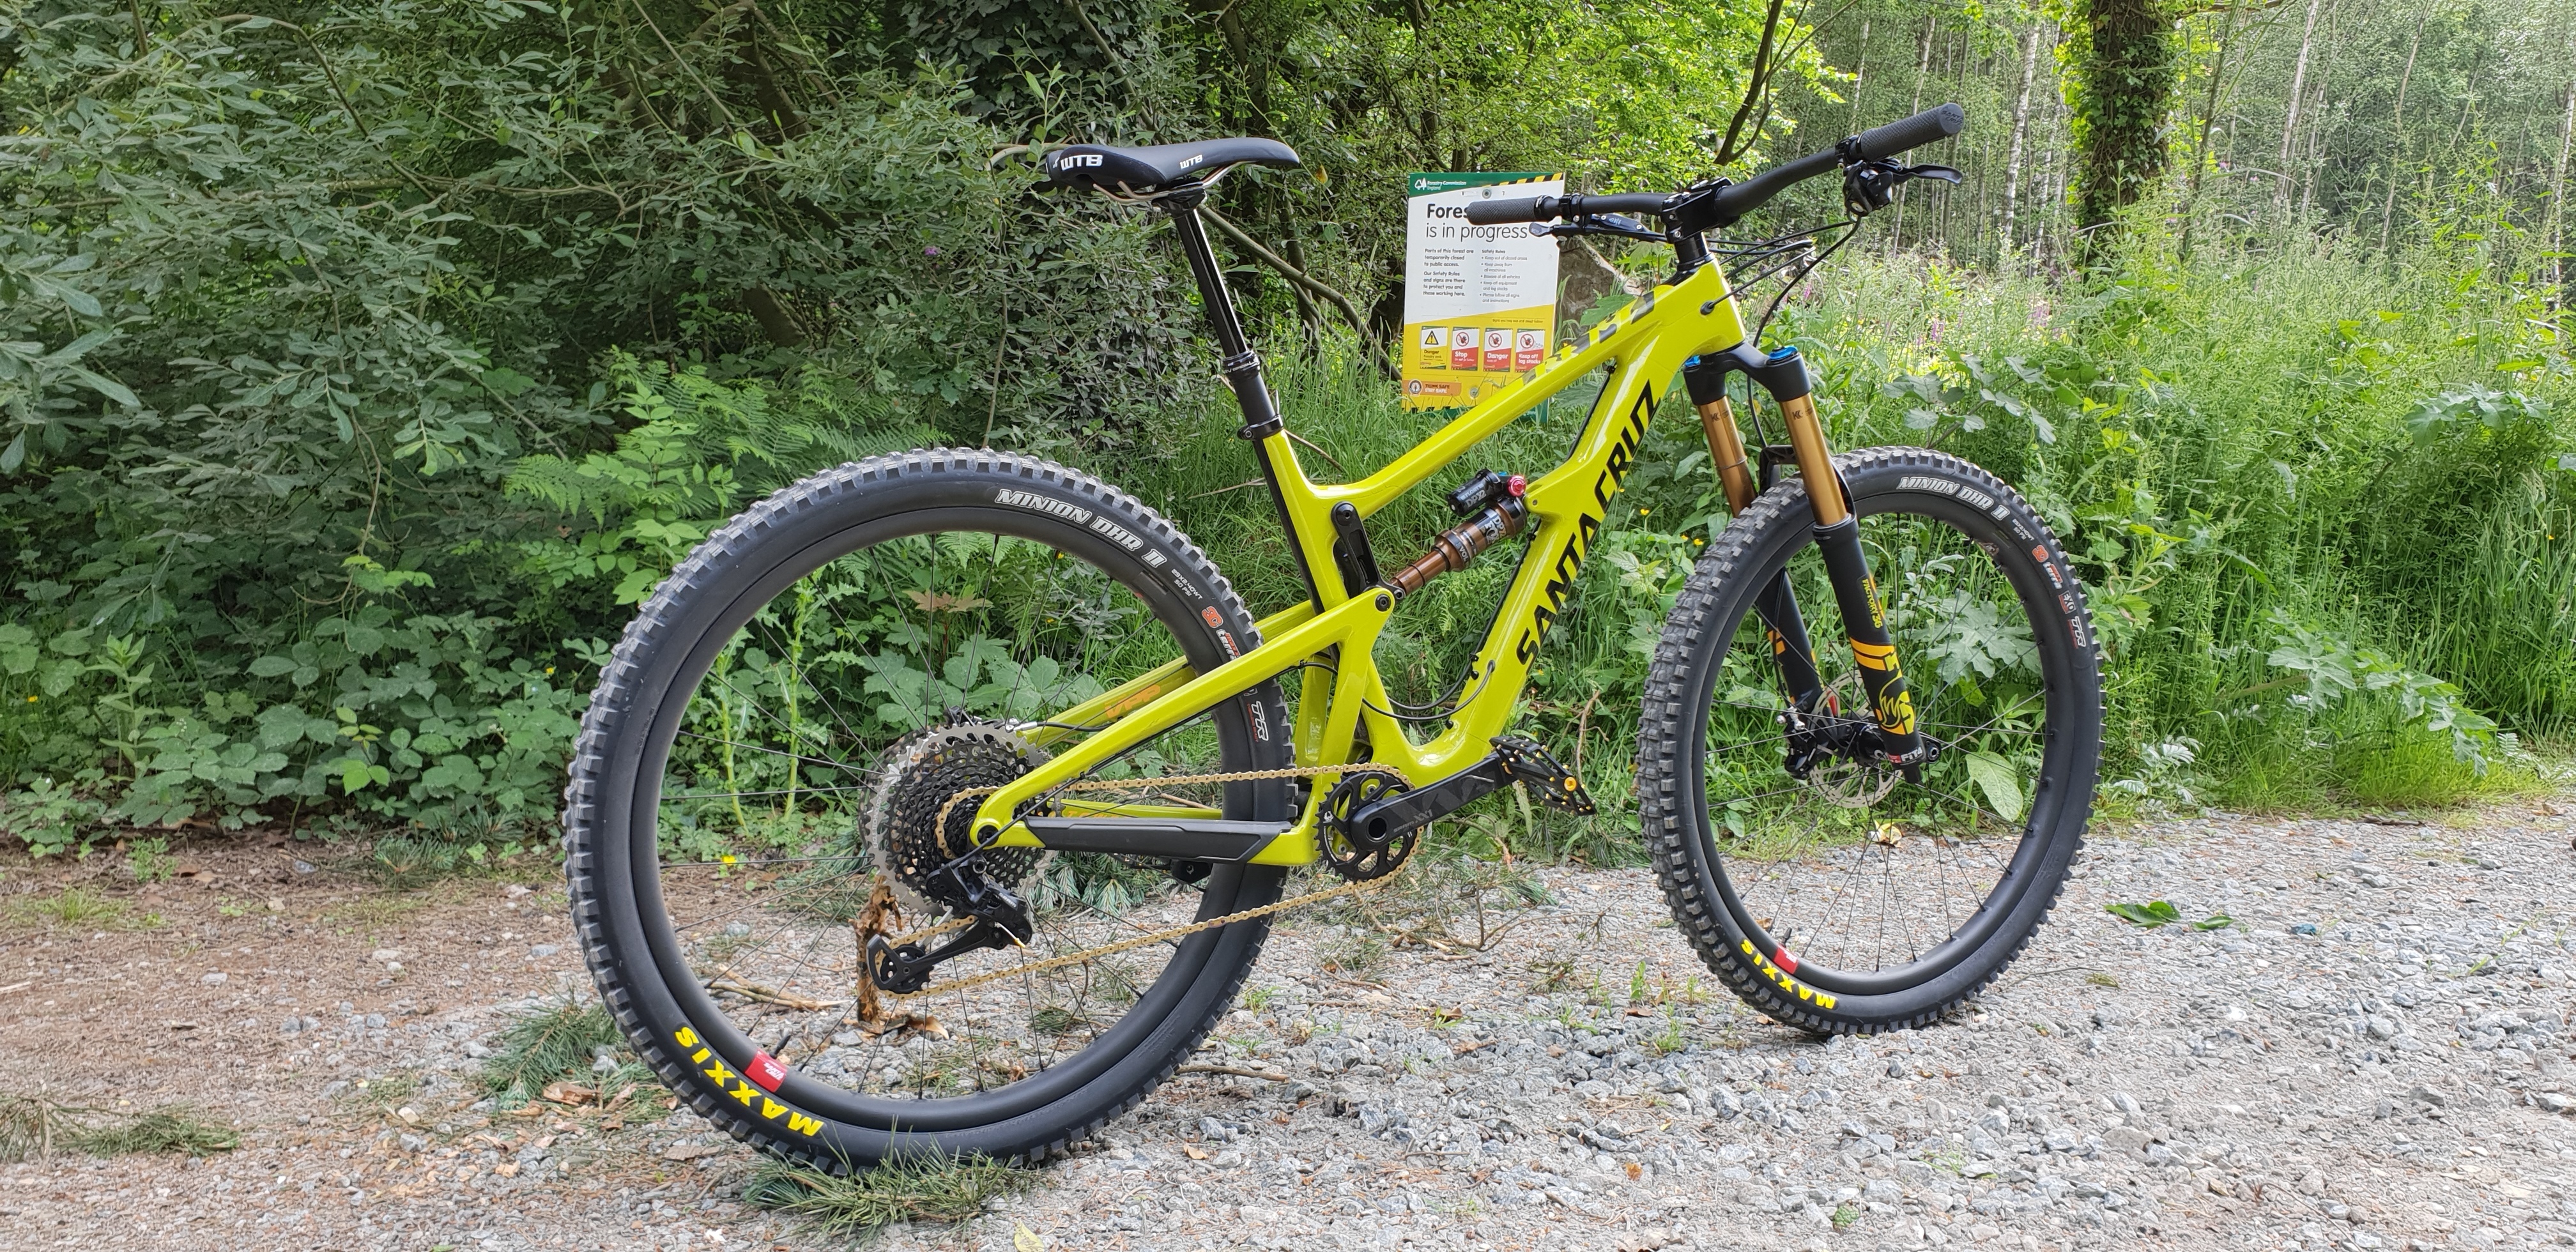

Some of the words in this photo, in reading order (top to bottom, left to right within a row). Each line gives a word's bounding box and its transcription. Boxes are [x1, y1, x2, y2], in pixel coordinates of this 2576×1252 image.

[1061, 155, 1103, 171] WTB
[1180, 155, 1203, 169] WTB
[1426, 222, 1437, 238] is
[1442, 222, 1455, 238] in
[1460, 226, 1528, 243] progress
[1466, 489, 1487, 508] DPX2
[1896, 477, 1960, 495] MINION
[1956, 486, 1994, 510] DHR
[994, 489, 1092, 524] MINION
[1089, 516, 1144, 551] DHR
[1485, 520, 1499, 544] FOX
[1516, 512, 1601, 676] SANTA
[1594, 379, 1661, 515] CRUZ
[1181, 586, 1192, 597] PSI
[1862, 578, 1878, 616] FACTORY
[1872, 613, 1883, 629] 36
[2062, 591, 2076, 611] EXO
[1201, 606, 1223, 629] 3C
[2071, 616, 2087, 647] TR
[1105, 684, 1161, 719] VPP
[1251, 701, 1269, 741] TR
[1741, 939, 1837, 1009] MAXXIS
[675, 1027, 824, 1136] MAXXIS
